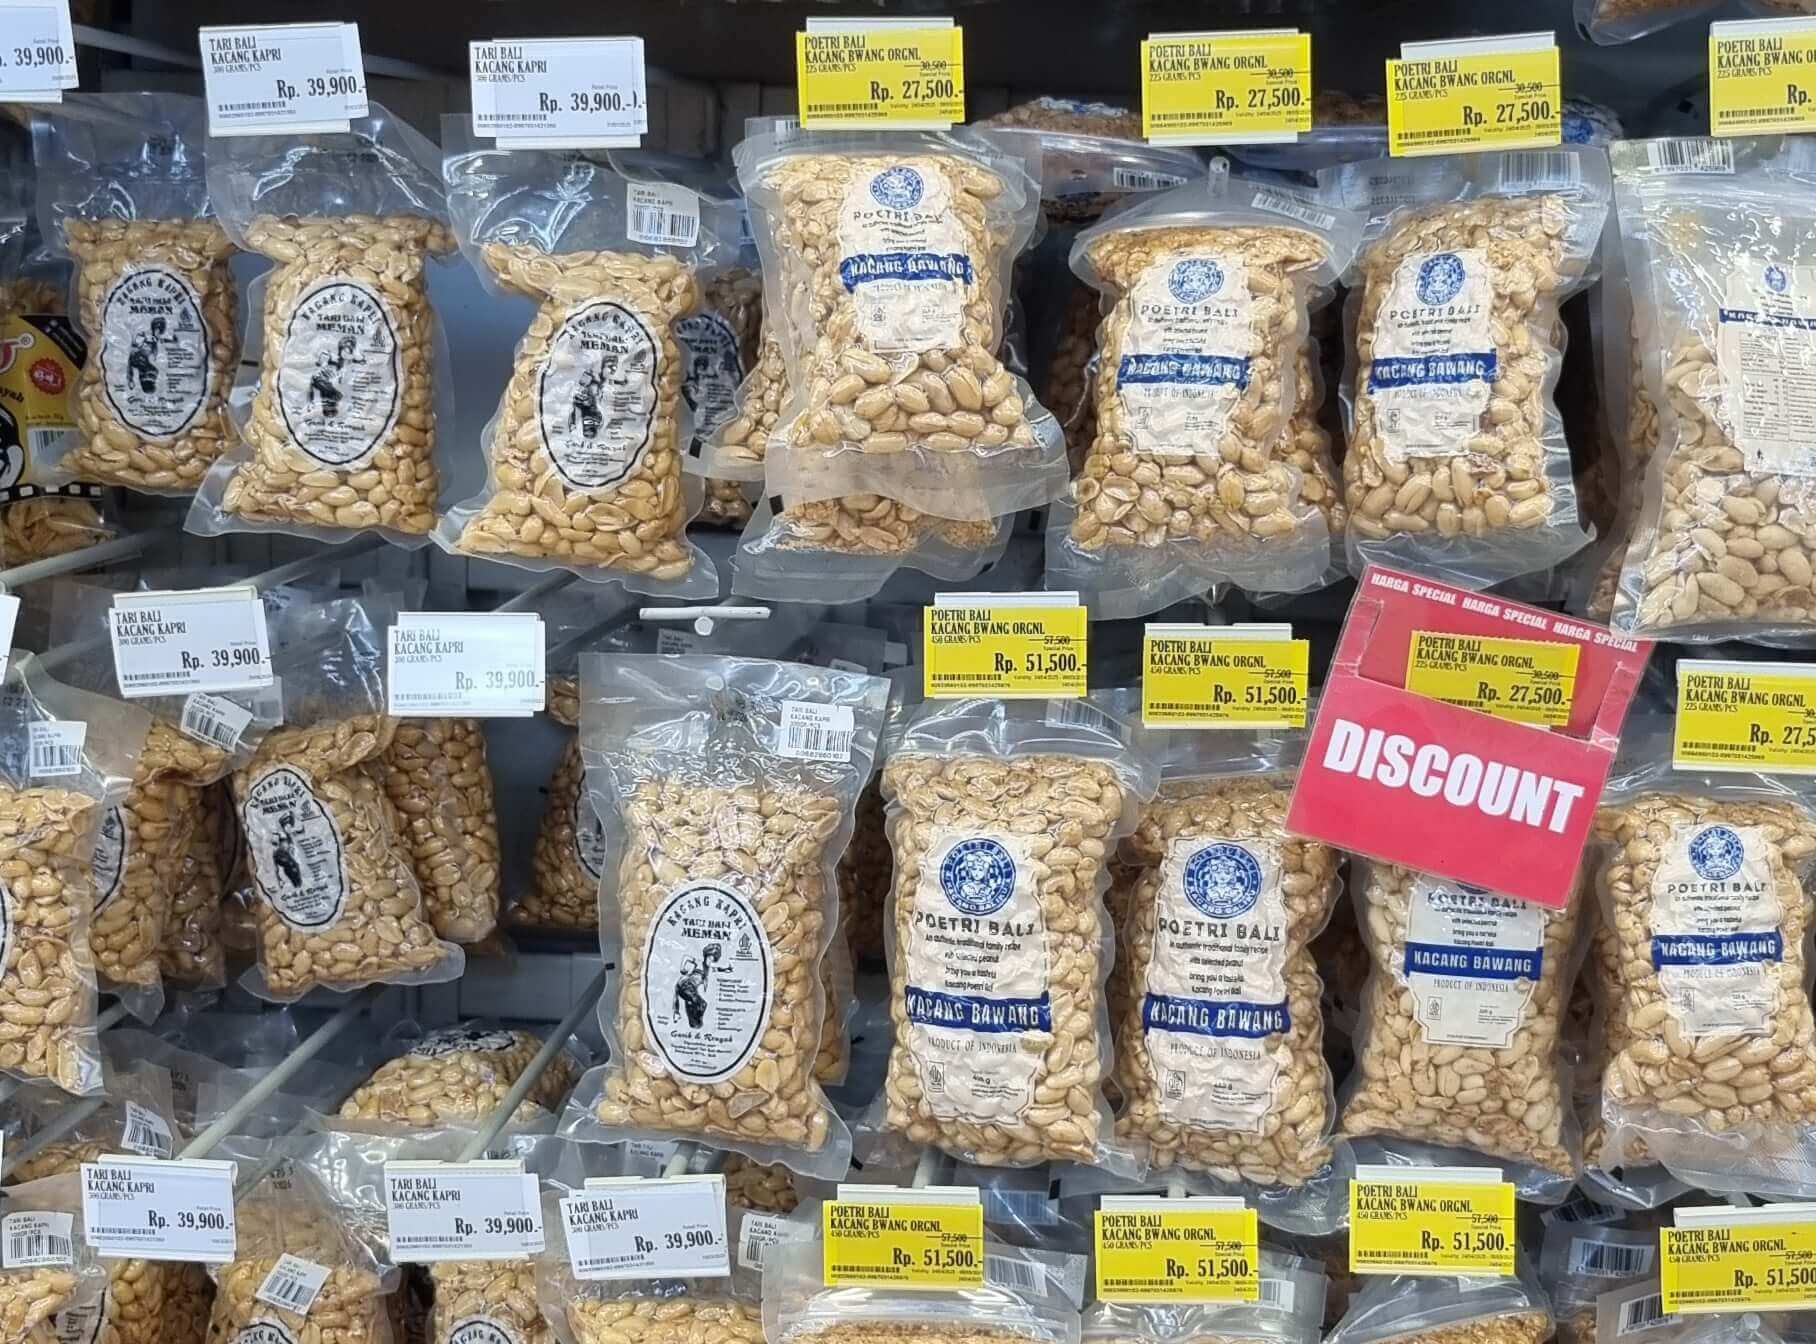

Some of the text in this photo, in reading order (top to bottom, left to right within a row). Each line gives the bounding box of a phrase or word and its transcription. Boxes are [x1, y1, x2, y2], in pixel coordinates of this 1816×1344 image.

[209, 36, 256, 51] TARI BALI
[804, 35, 865, 50] POETRI BALI
[211, 48, 281, 65] KACANG KAPRI
[804, 47, 921, 64] KACANG BWANG ORGNL
[277, 79, 300, 99] Rp.
[870, 81, 893, 101] Rp.
[931, 609, 991, 621] POETRI BALI
[1370, 573, 1639, 653] HARGA SPECIAL HARGA SPECIAL HARGA SPECIAL
[931, 622, 1045, 635] KACANG BWANG ORGNL
[1418, 636, 1481, 653] POETRI BALI
[994, 653, 1088, 673] Rp. 51,500.-
[1417, 649, 1535, 669] KACANG BWANG ORGNL
[1477, 682, 1501, 702] Rp.
[1323, 718, 1585, 834] DISCOUNT
[914, 911, 1034, 936] POETRI BALI
[1414, 950, 1532, 972] KACANG BAWANG
[905, 995, 1040, 1027] KACANG BAWANG
[1101, 1216, 1162, 1227] POETRI BALI
[1101, 1228, 1216, 1241] KACANG BWANG ORGNL
[1166, 1259, 1259, 1278] Rp. 51,500.-
